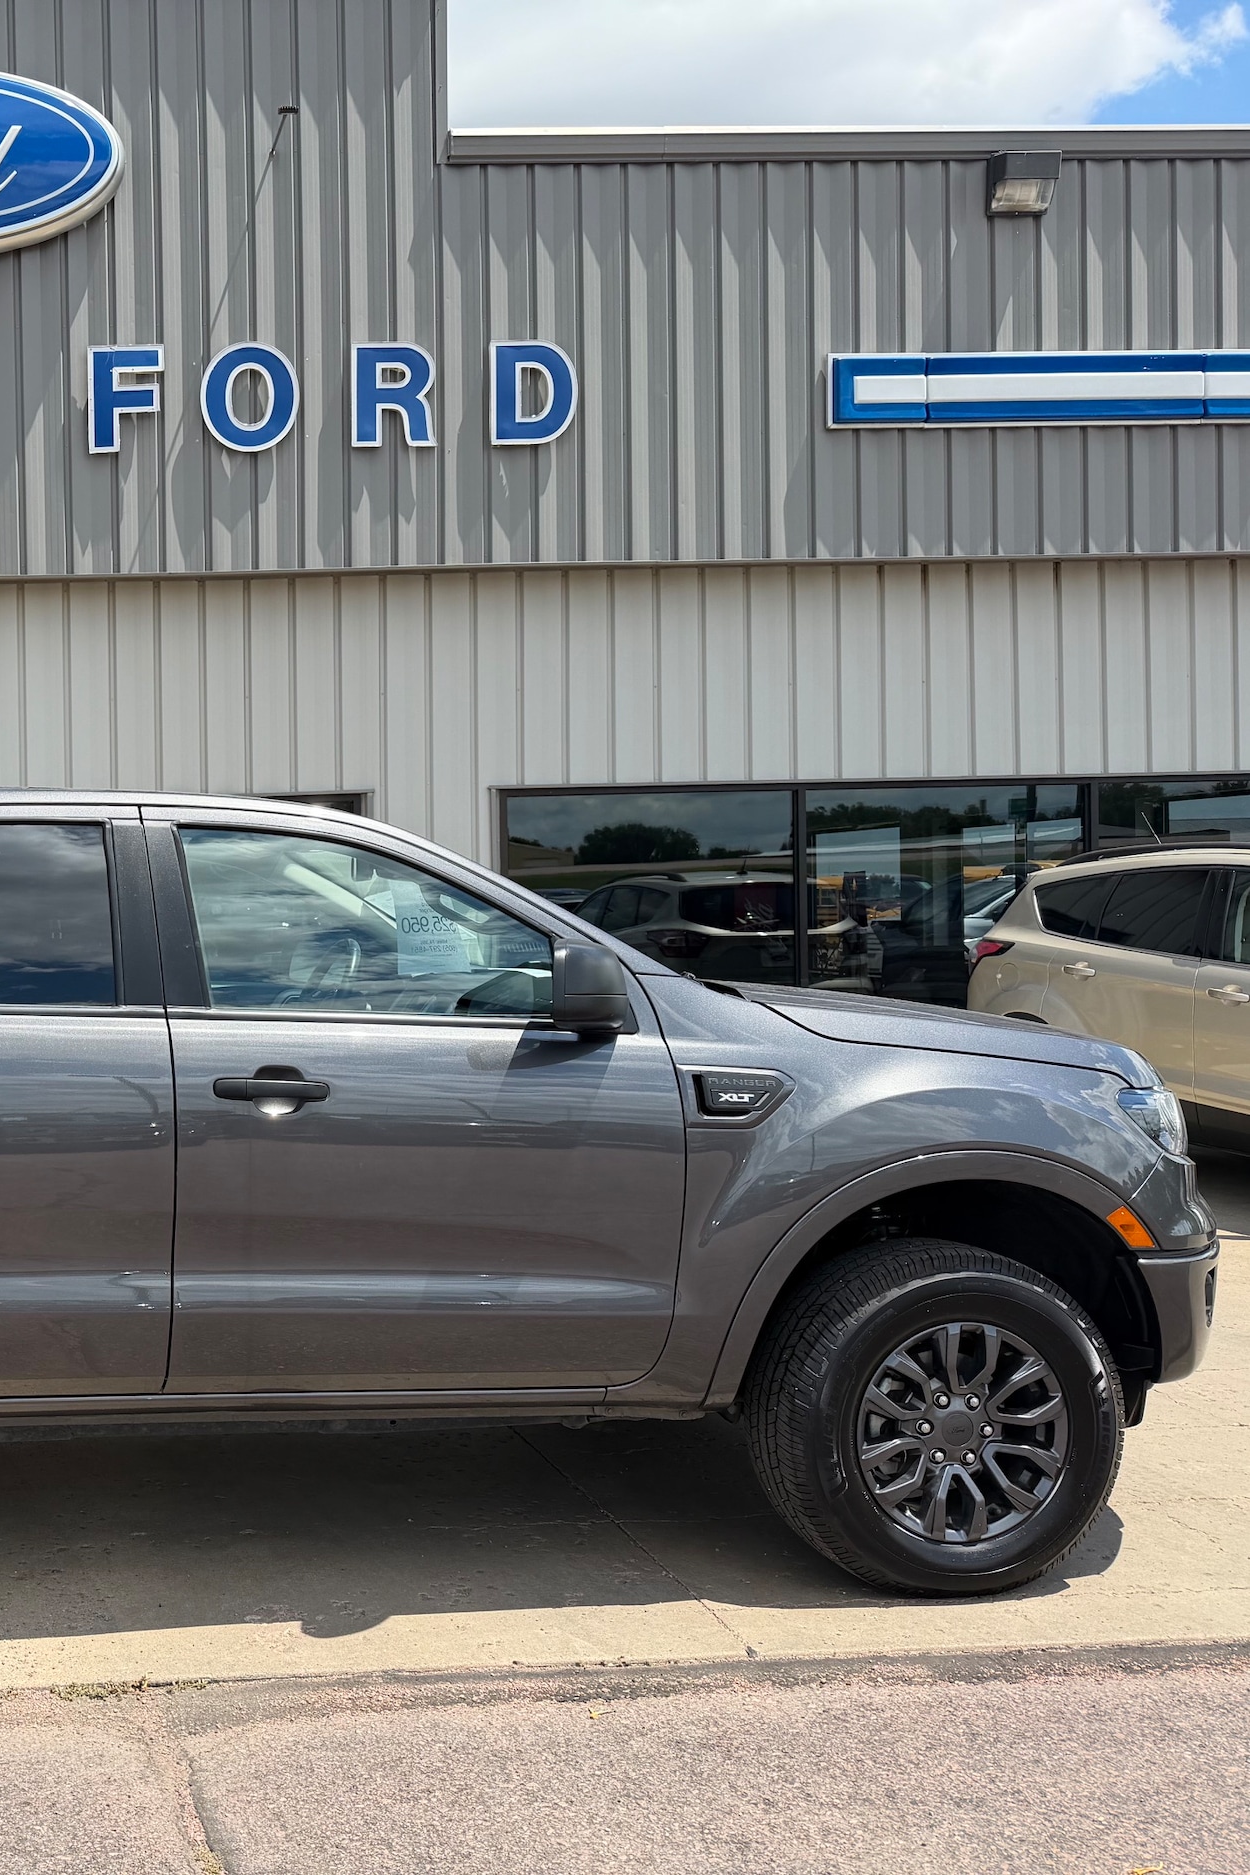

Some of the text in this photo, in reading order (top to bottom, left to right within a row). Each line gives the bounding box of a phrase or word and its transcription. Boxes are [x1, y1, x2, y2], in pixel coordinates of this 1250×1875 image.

[87, 339, 579, 454] FORD
[708, 1077, 777, 1087] RANGER
[718, 1092, 755, 1103] XLT
